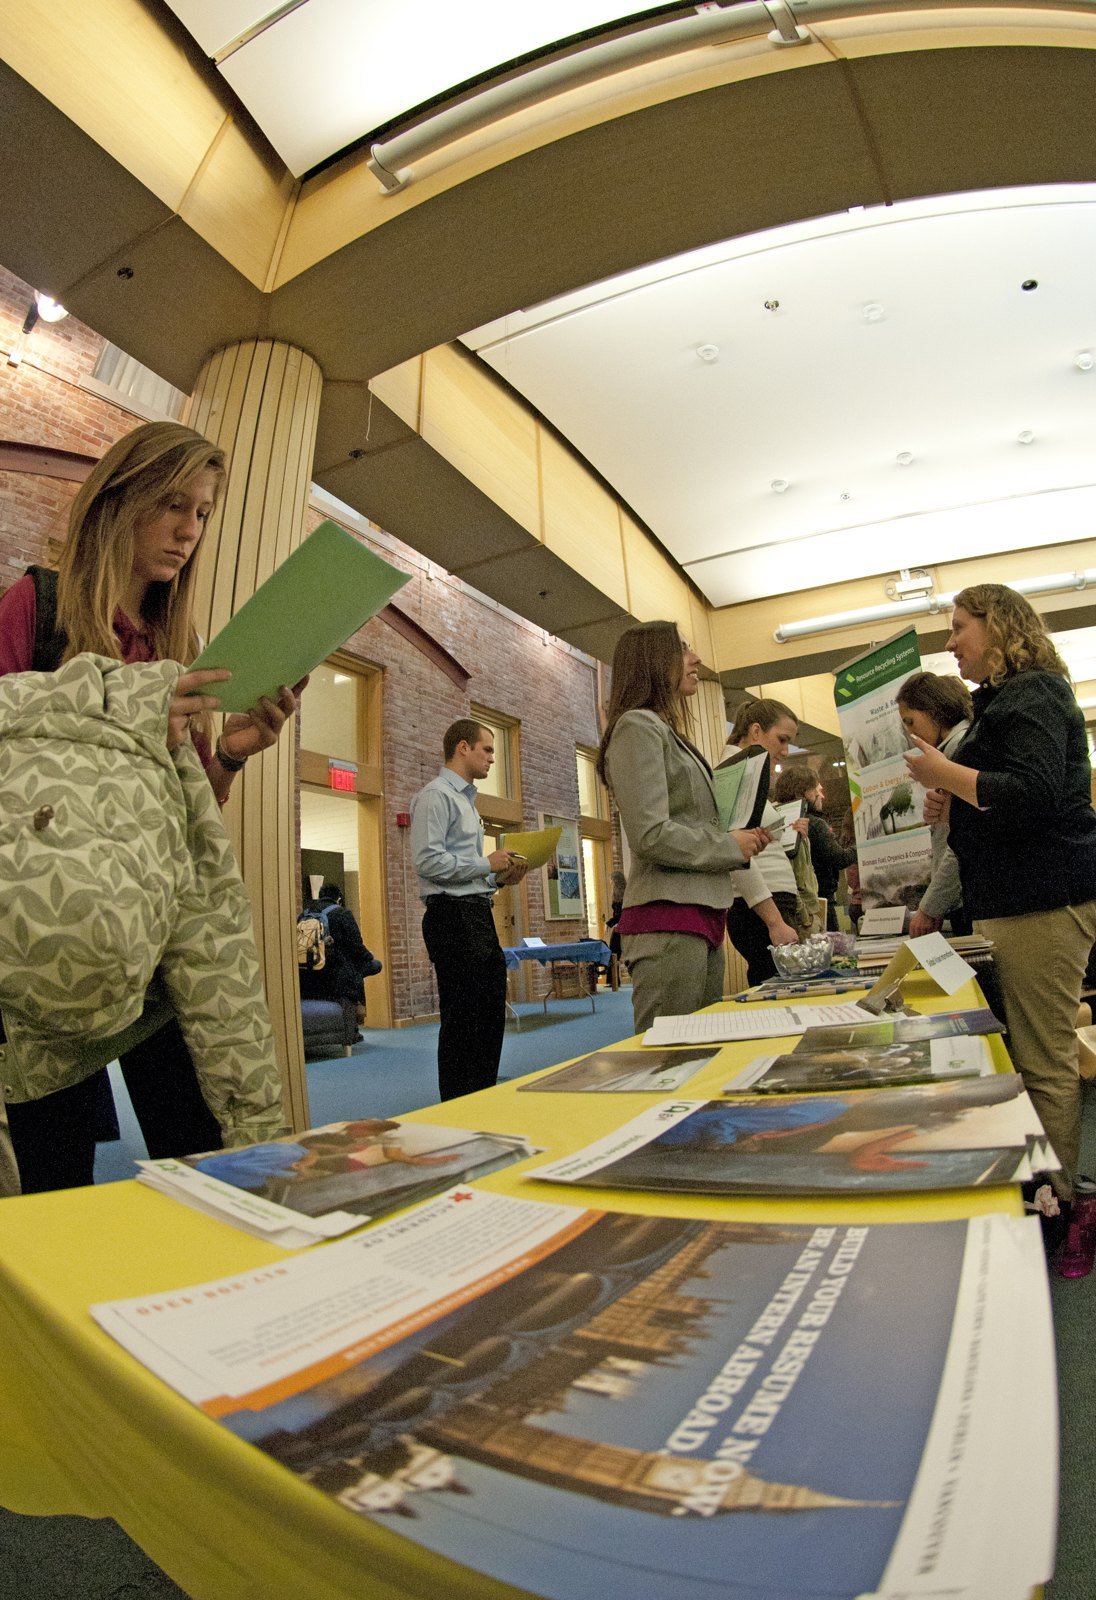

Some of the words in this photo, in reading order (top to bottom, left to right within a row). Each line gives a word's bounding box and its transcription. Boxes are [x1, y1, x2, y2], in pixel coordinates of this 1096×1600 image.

[856, 668, 875, 683] Resource
[875, 657, 896, 673] Recycling
[895, 646, 915, 662] Systems
[335, 769, 355, 791] EXIT
[887, 853, 905, 862] Organics
[806, 1227, 837, 1249] BE
[830, 1227, 869, 1275] BUILD
[793, 1248, 824, 1272] AN
[744, 1271, 812, 1346] INTERN
[798, 1275, 847, 1328] YOUR
[732, 1329, 821, 1435] RESUME
